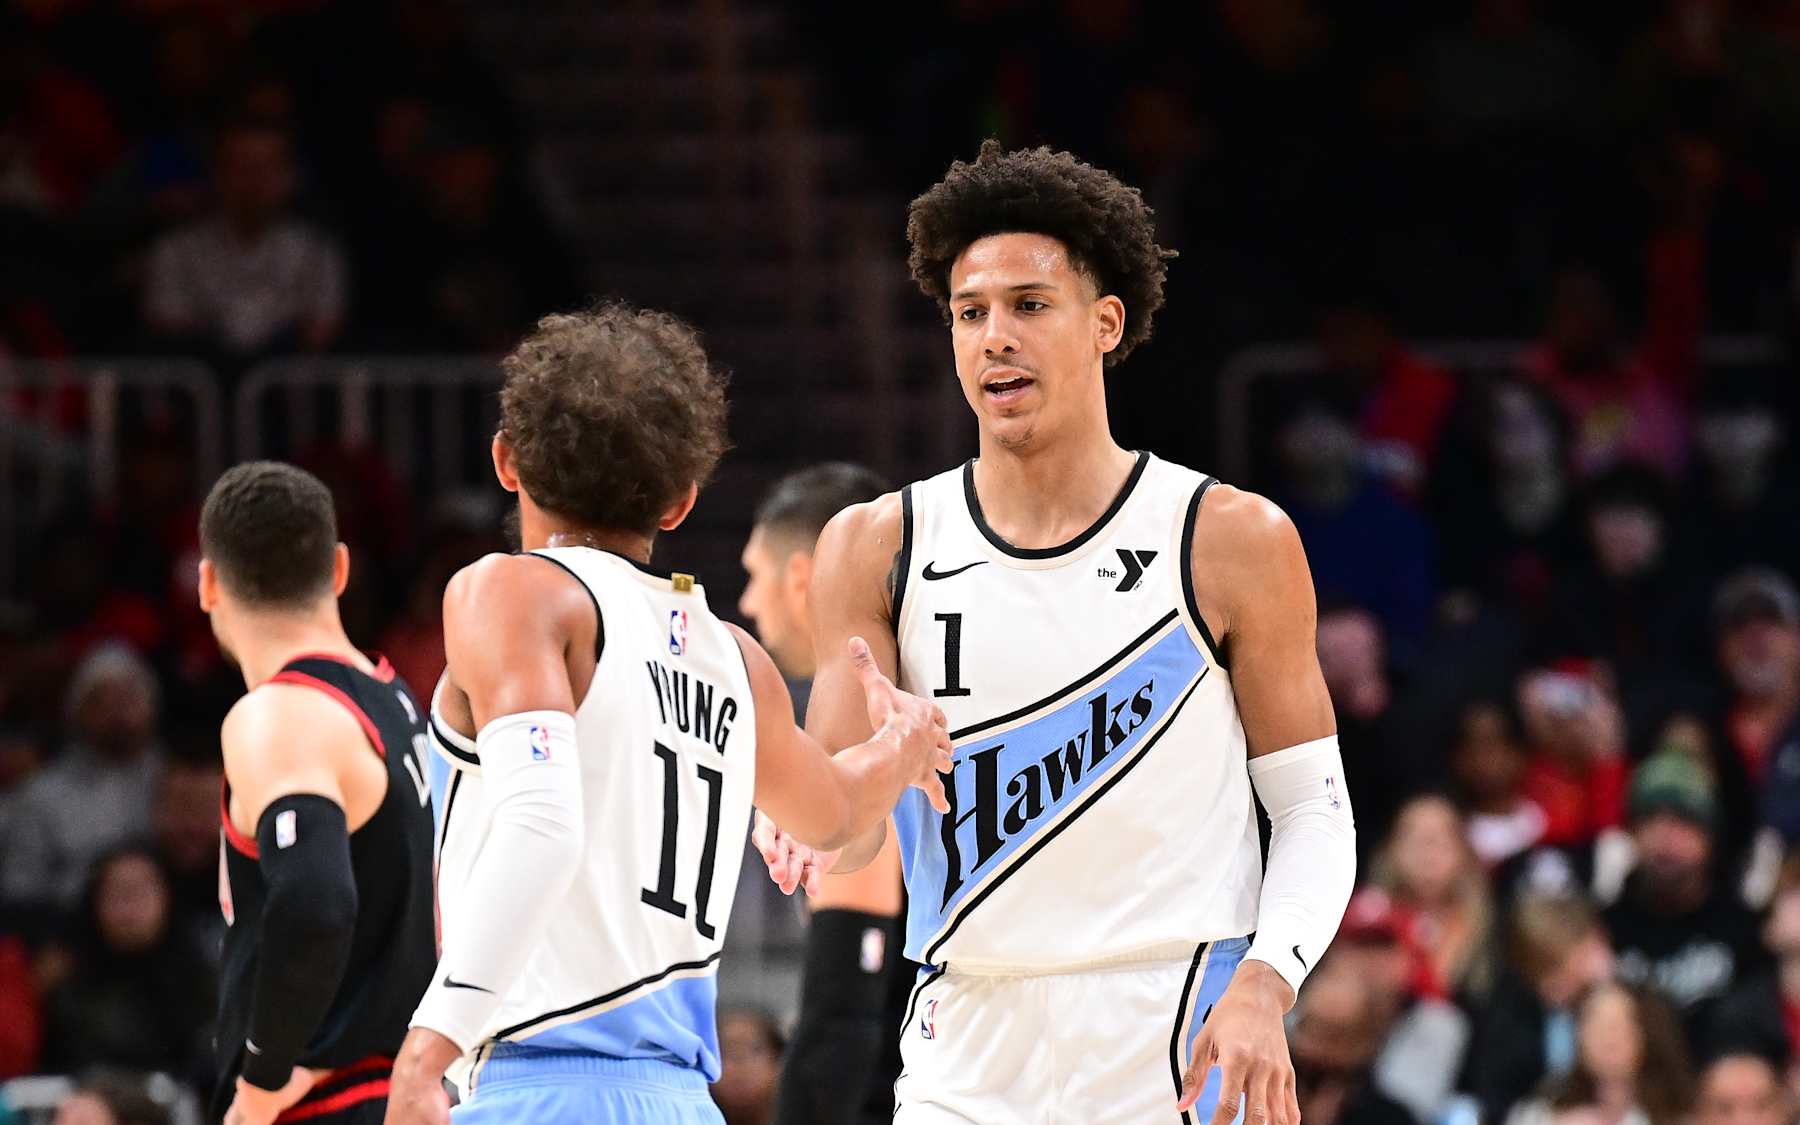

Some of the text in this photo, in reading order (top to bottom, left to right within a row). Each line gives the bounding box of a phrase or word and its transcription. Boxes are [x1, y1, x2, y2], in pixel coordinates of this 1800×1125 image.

[1097, 568, 1117, 579] the
[933, 612, 972, 698] 1
[641, 739, 723, 940] 11
[939, 679, 1155, 916] Hawks
